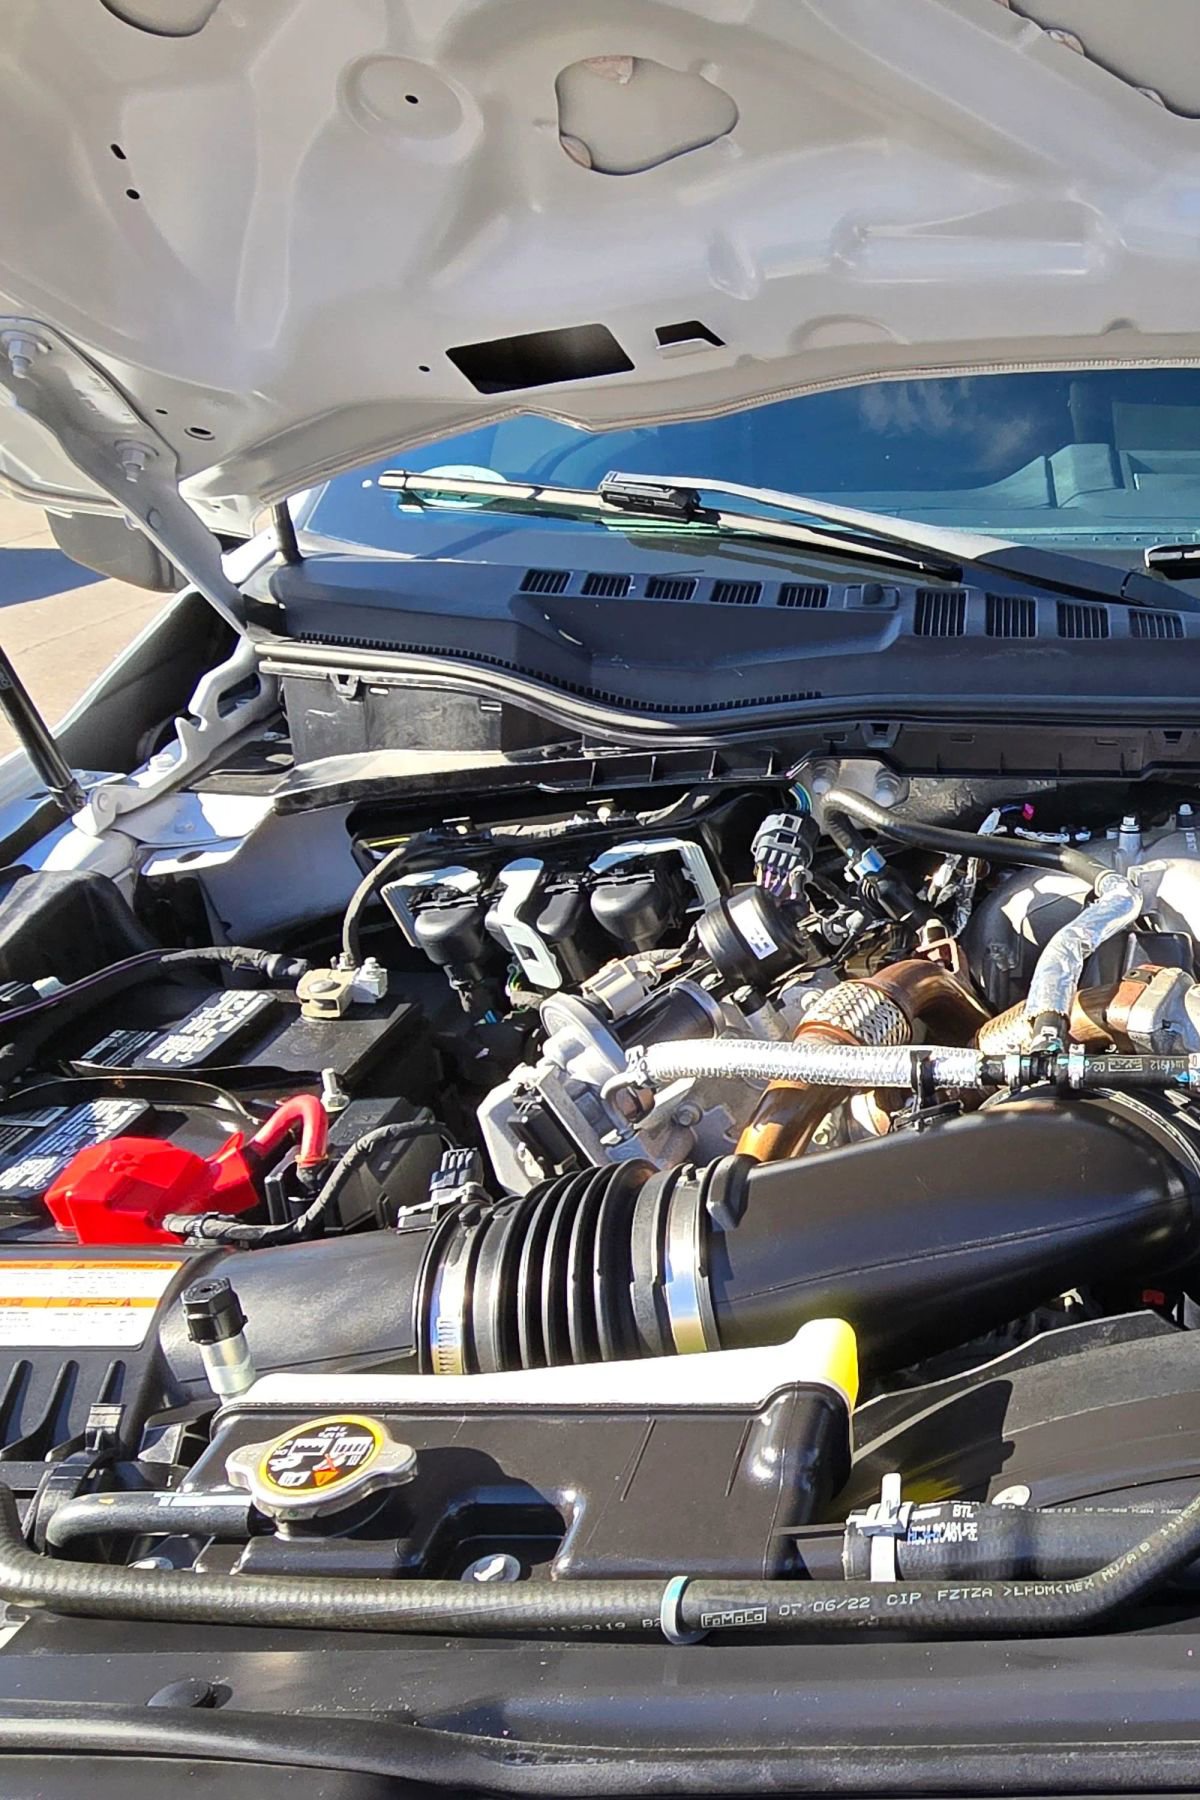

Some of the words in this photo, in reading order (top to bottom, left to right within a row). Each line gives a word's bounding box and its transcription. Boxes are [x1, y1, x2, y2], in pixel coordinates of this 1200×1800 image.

[701, 1607, 768, 1629] FoMoCo
[886, 1592, 922, 1606] CIP
[1065, 1577, 1095, 1595] MEX
